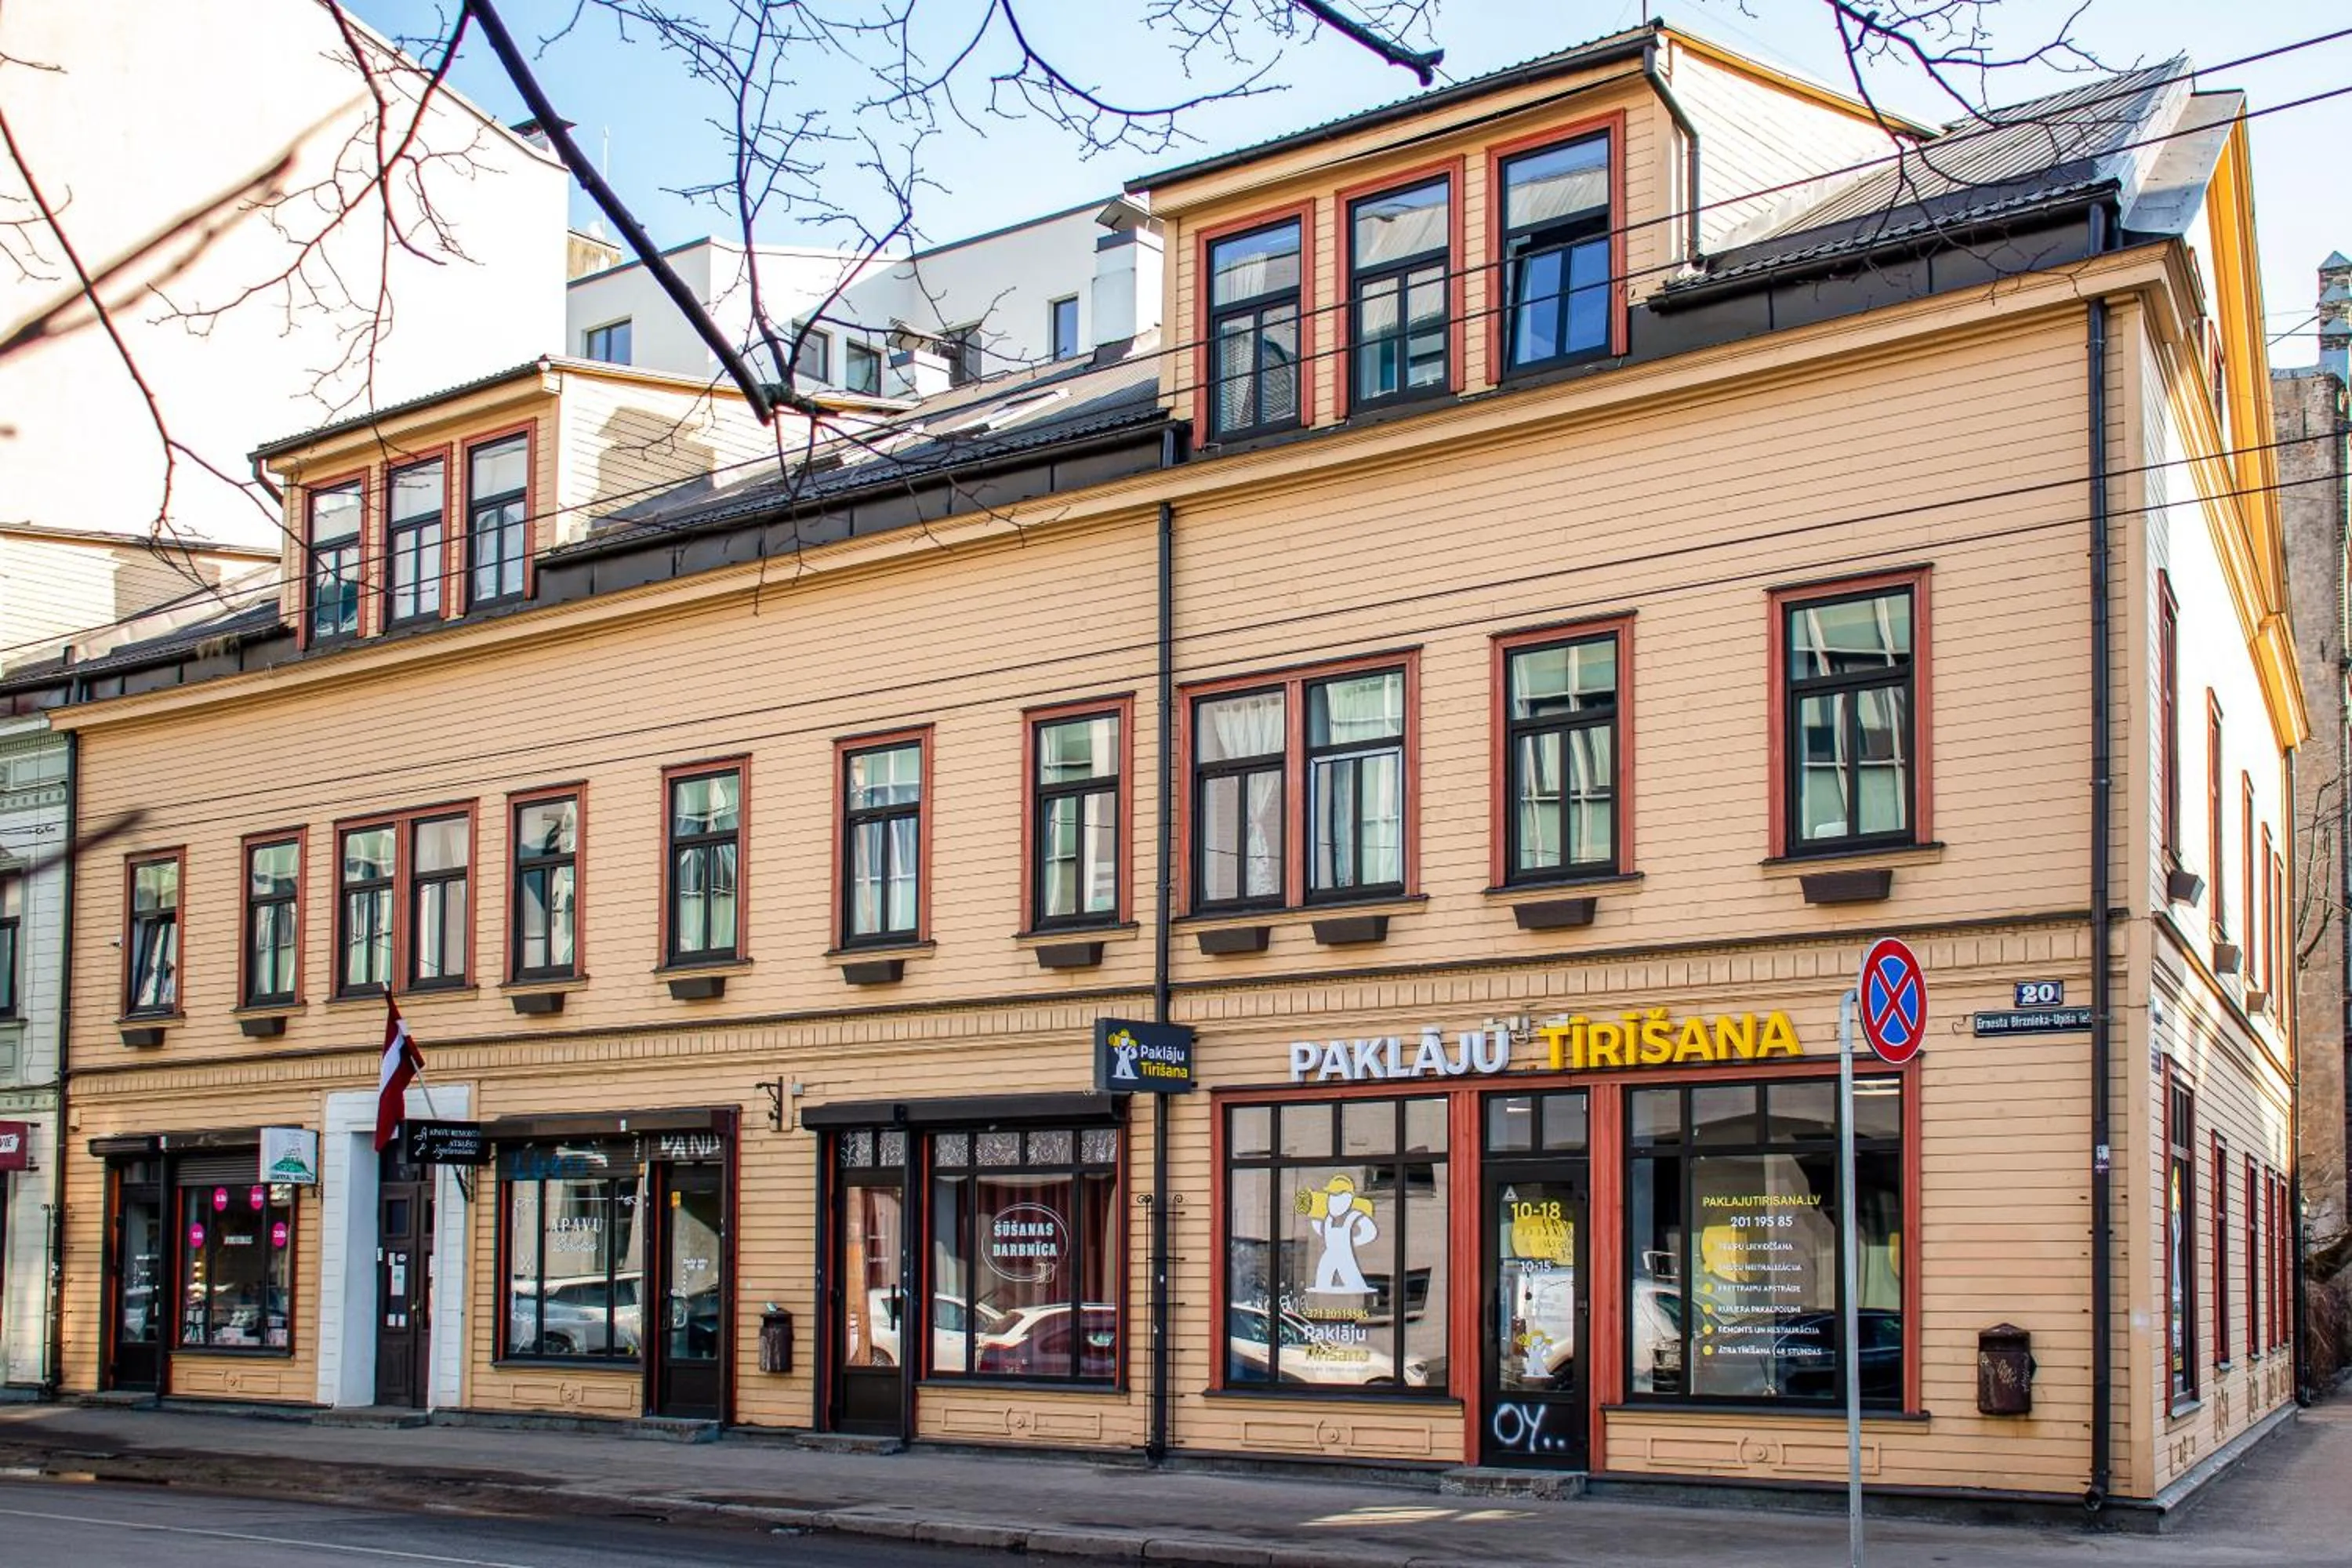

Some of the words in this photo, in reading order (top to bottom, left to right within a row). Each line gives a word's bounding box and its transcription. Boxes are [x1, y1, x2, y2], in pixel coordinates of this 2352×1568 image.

[2022, 984, 2055, 1003] 20
[1976, 1017, 2008, 1029] Ernesta
[1290, 1027, 1510, 1082] PAKLĀJU
[1539, 1007, 1805, 1070] TĪRĪŠANA
[1140, 1044, 1185, 1064] Paklāju
[1140, 1061, 1188, 1079] Tīrīšana
[1702, 1194, 1821, 1207] PAKLAJUTIRISANA.LV
[1511, 1202, 1561, 1220] 10-18
[550, 1218, 604, 1233] APAVU
[993, 1221, 1054, 1237] ŠŪŠANAS
[1730, 1216, 1751, 1227] 201
[1755, 1216, 1773, 1227] 195
[1777, 1216, 1793, 1227] 85
[993, 1241, 1058, 1257] DARBNĪCA
[1304, 1323, 1367, 1345] Paklāju
